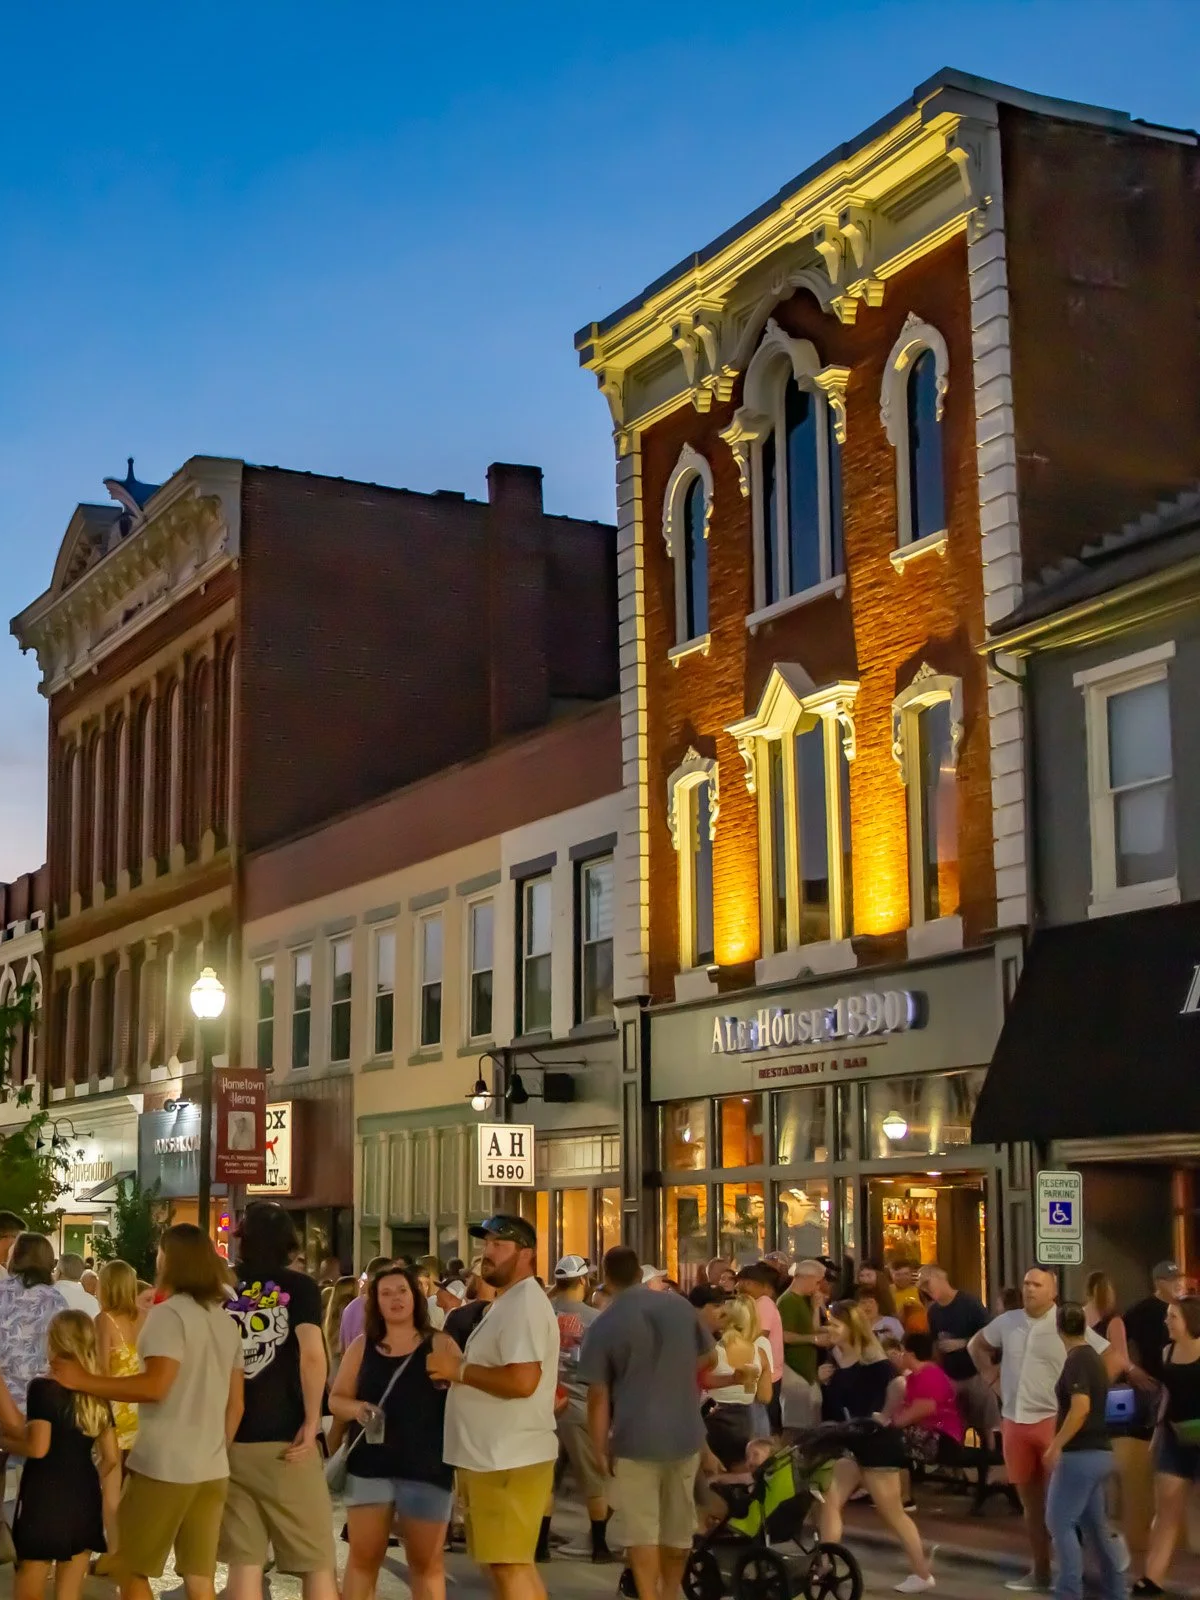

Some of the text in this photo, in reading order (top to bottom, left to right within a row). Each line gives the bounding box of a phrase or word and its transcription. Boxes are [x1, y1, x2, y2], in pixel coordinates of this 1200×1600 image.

[833, 990, 906, 1037] 1890
[222, 1077, 265, 1094] Hometown
[488, 1164, 524, 1179] 1890
[1040, 1179, 1079, 1188] RESERVED
[1044, 1190, 1075, 1199] PARKING
